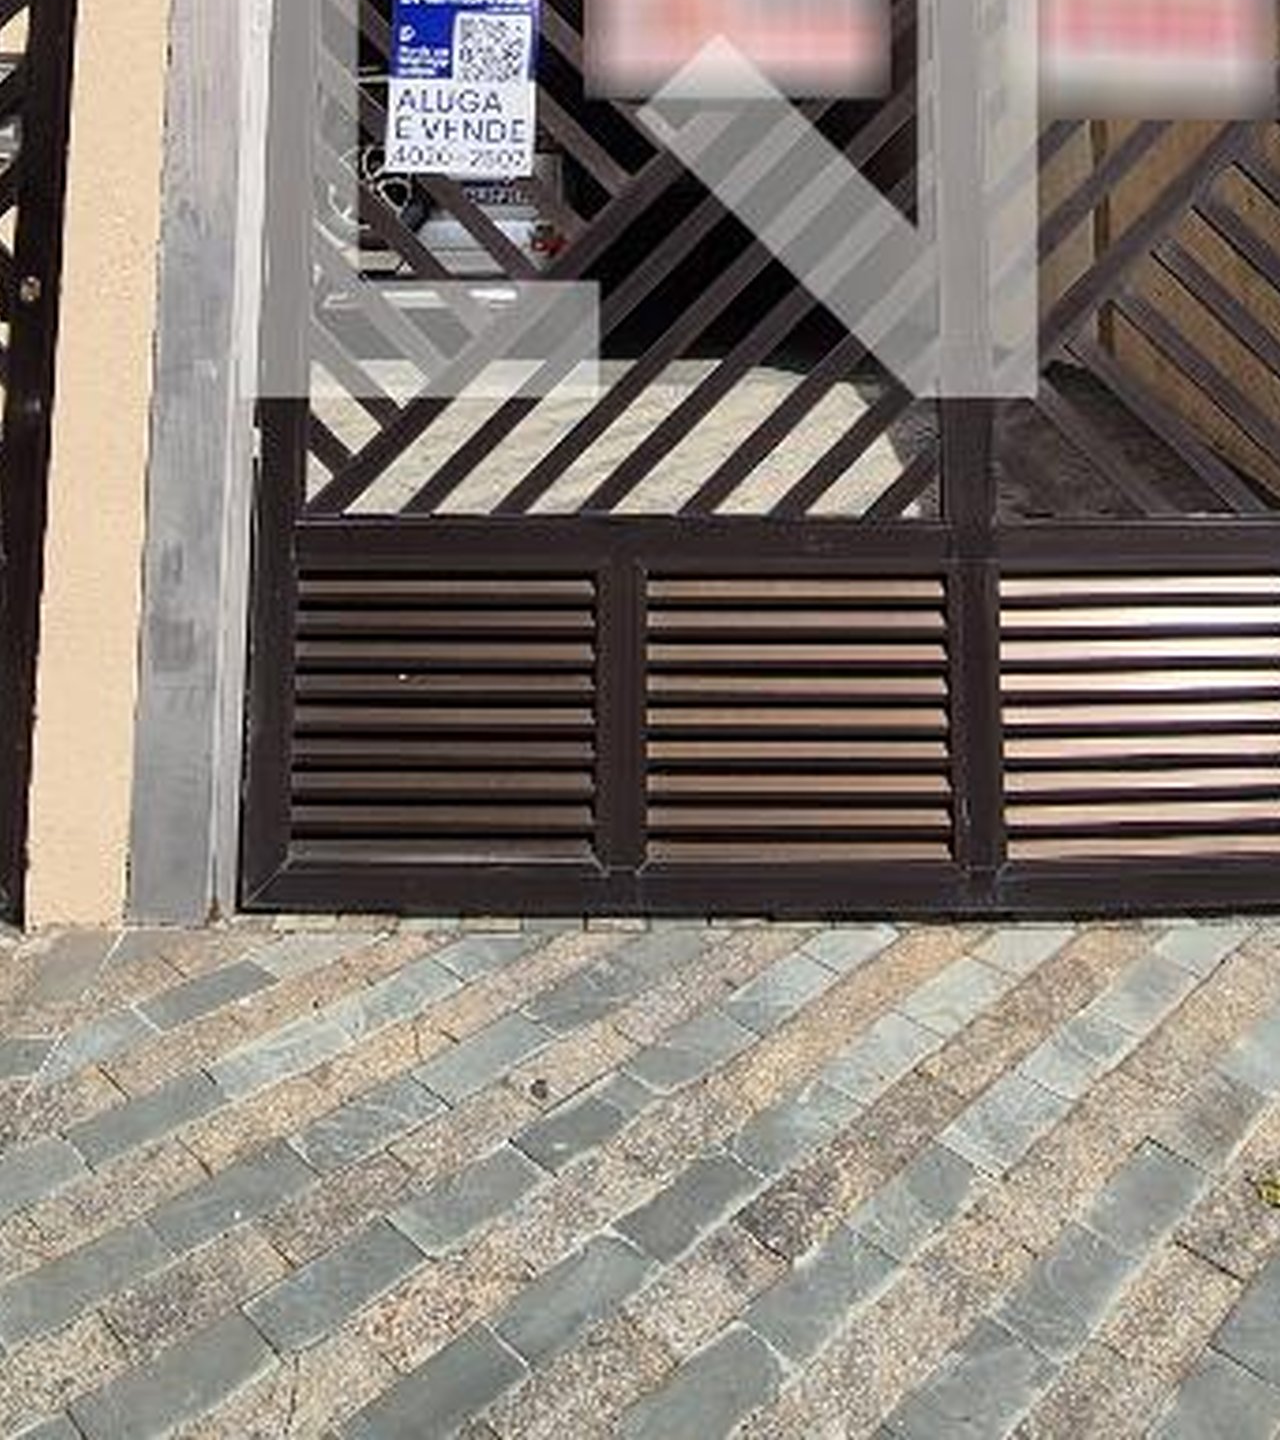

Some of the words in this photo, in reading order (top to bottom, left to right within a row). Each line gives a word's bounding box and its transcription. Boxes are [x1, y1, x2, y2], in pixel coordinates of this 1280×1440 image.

[396, 88, 503, 114] ALUGA
[395, 115, 412, 140] E
[421, 118, 526, 144] VENDE
